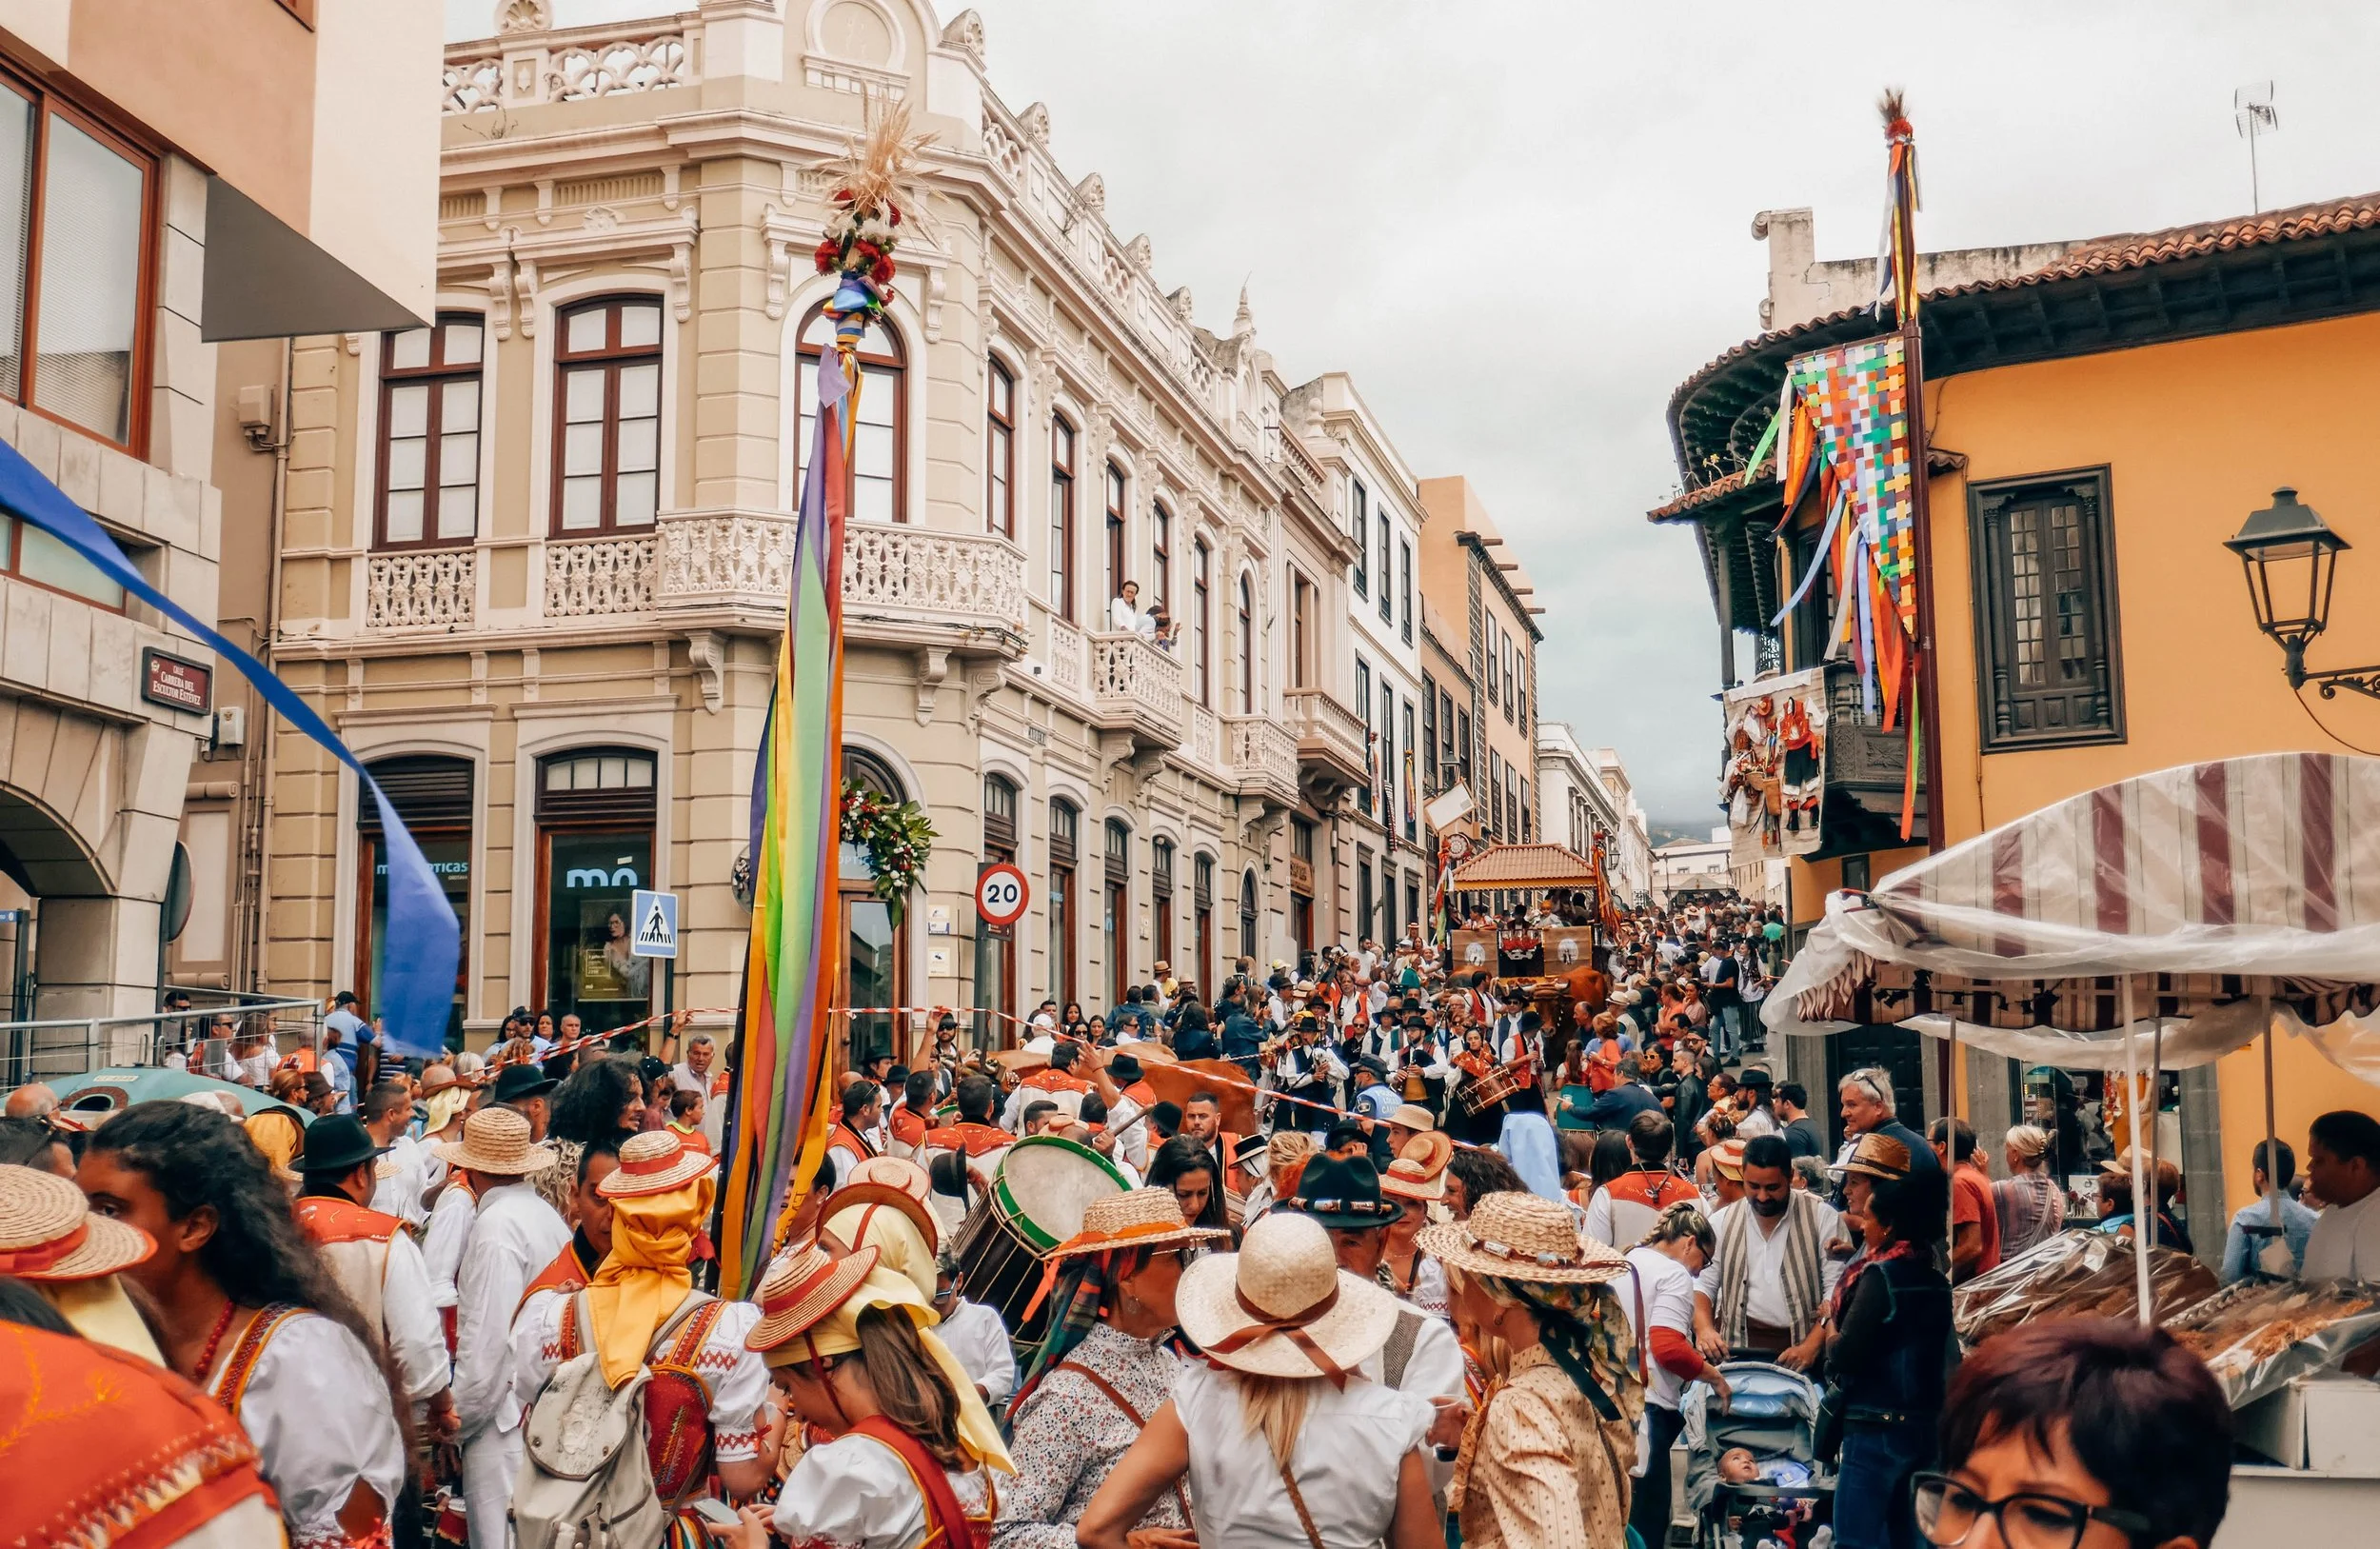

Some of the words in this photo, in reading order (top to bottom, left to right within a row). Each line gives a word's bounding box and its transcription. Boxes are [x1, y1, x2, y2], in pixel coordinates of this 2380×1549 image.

[152, 681, 179, 699] ESCULTOR
[161, 671, 185, 688] CARRERA
[184, 680, 195, 692] DEL
[987, 884, 1018, 904] 20
